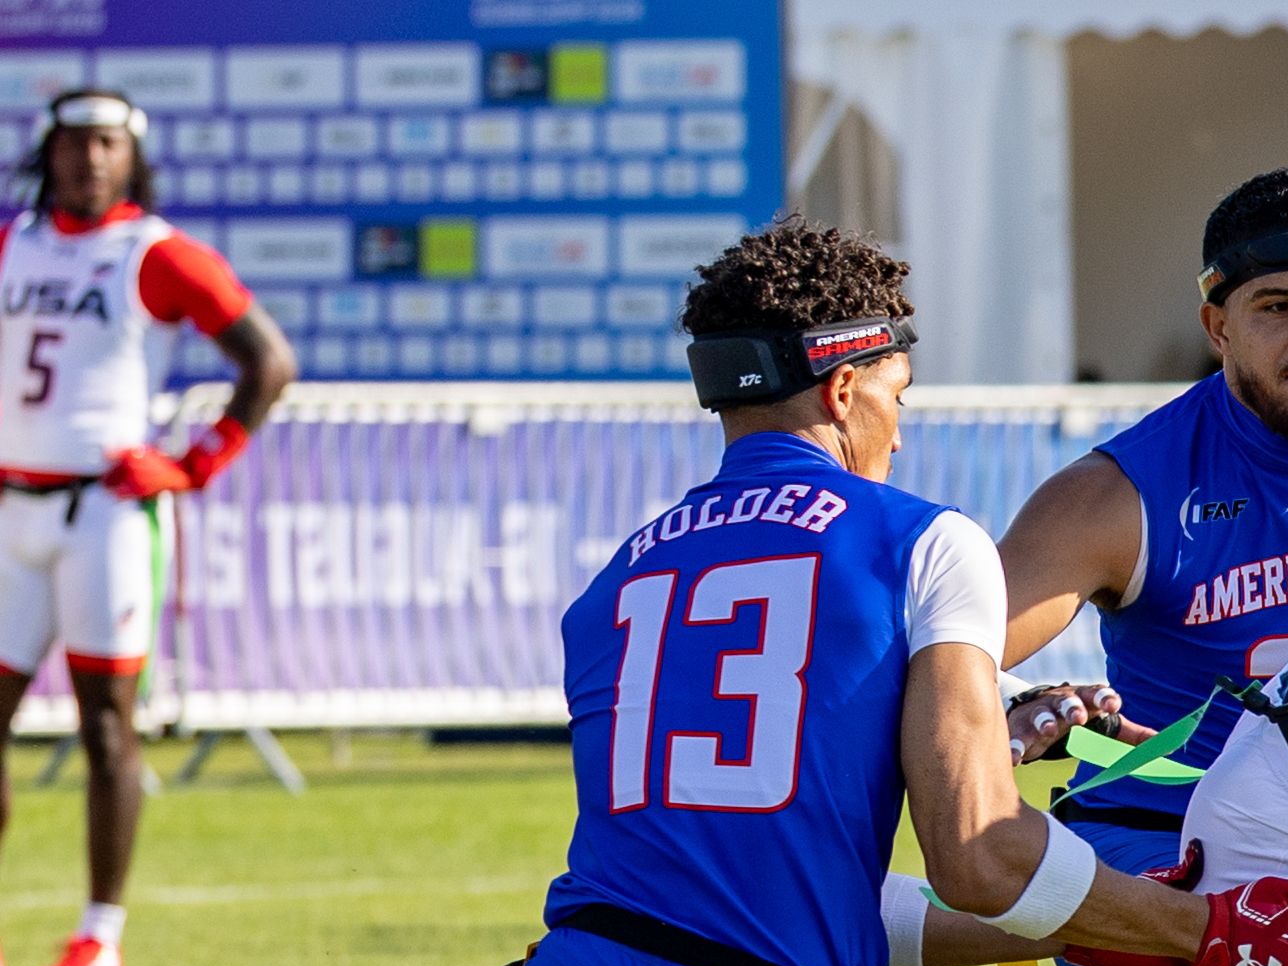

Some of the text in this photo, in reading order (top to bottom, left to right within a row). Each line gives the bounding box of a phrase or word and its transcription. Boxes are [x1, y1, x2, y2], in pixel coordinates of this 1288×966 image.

[3, 281, 109, 322] USA
[808, 333, 889, 359] SAMOA
[816, 326, 881, 346] AMERIKA
[21, 331, 63, 408] 5
[628, 484, 848, 568] HOLDER
[610, 552, 822, 815] 13
